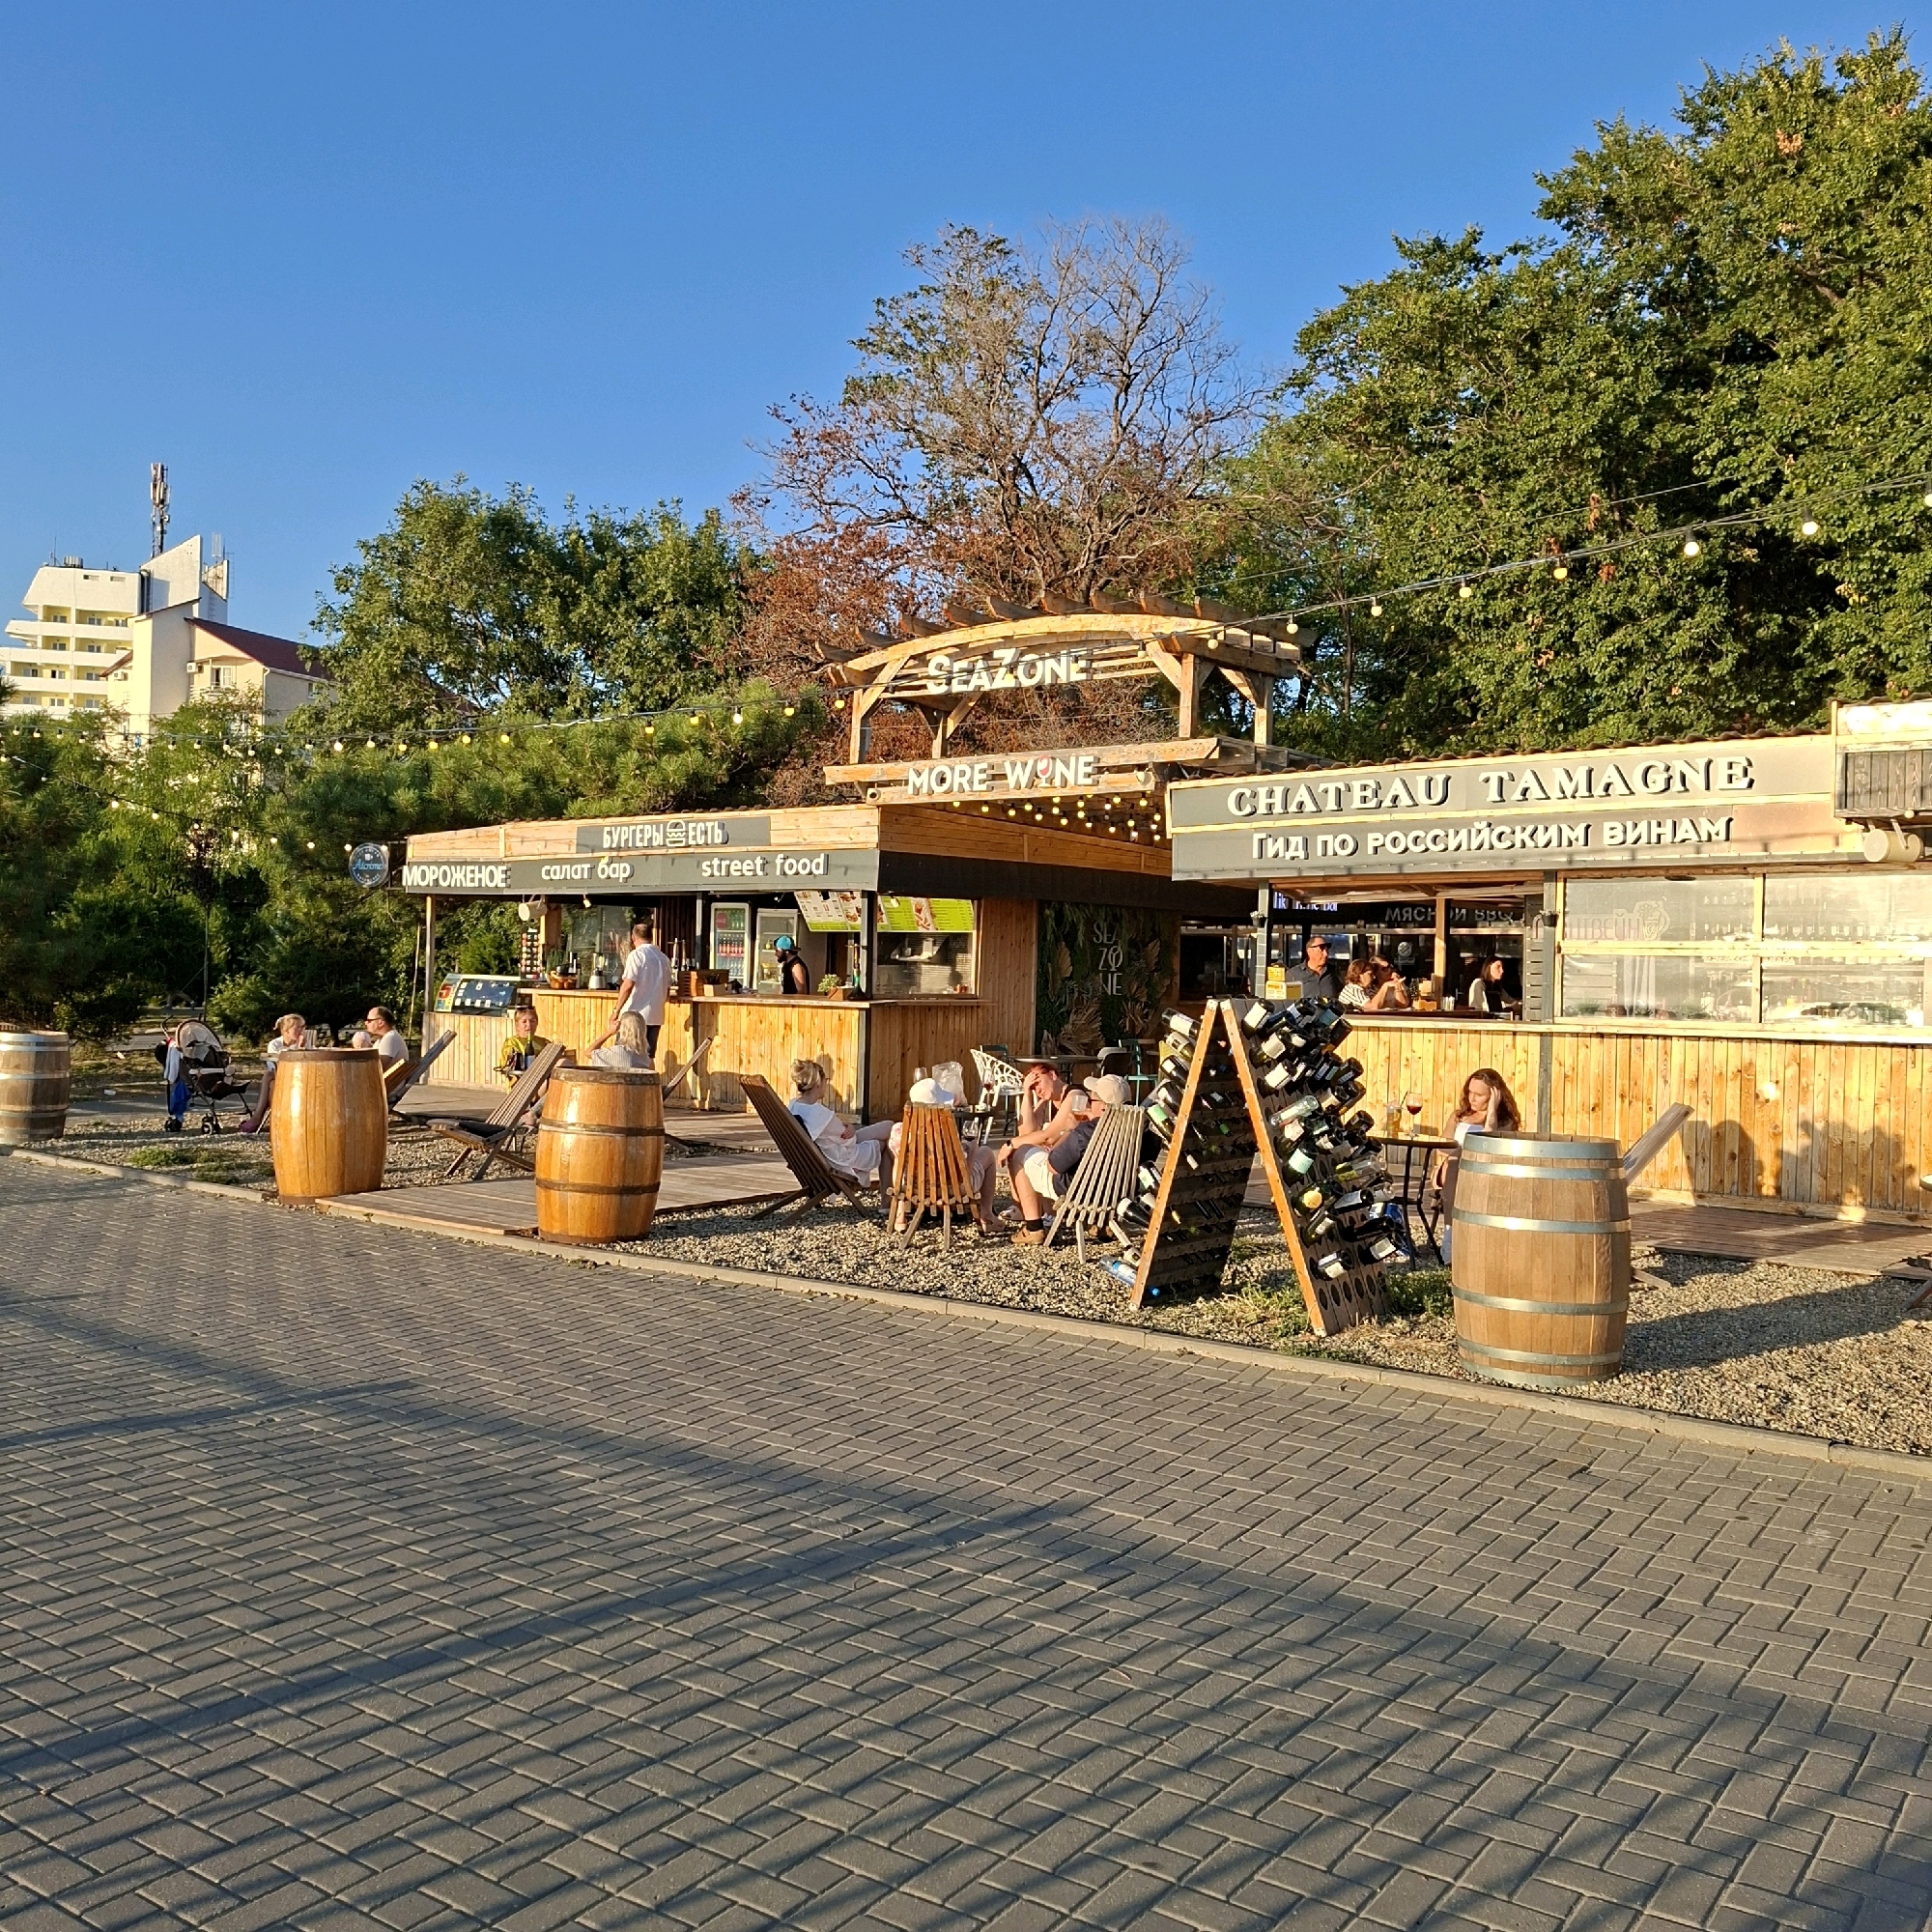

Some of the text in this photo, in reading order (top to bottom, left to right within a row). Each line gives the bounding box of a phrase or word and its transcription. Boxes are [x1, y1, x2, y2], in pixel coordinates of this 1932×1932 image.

[907, 762, 988, 795] MORE
[1227, 755, 1755, 816] CHATEAU TAMAGNE
[603, 820, 724, 848] БУРГЕРЫ ЕСТЬ
[1317, 833, 1357, 857] ПО
[1367, 819, 1591, 855] РОССИЙСКИМ
[1604, 816, 1734, 845] ВИНАМ
[402, 865, 508, 888] МОРОЖЕНОЕ
[541, 856, 634, 883] салат бар
[701, 853, 829, 878] street food
